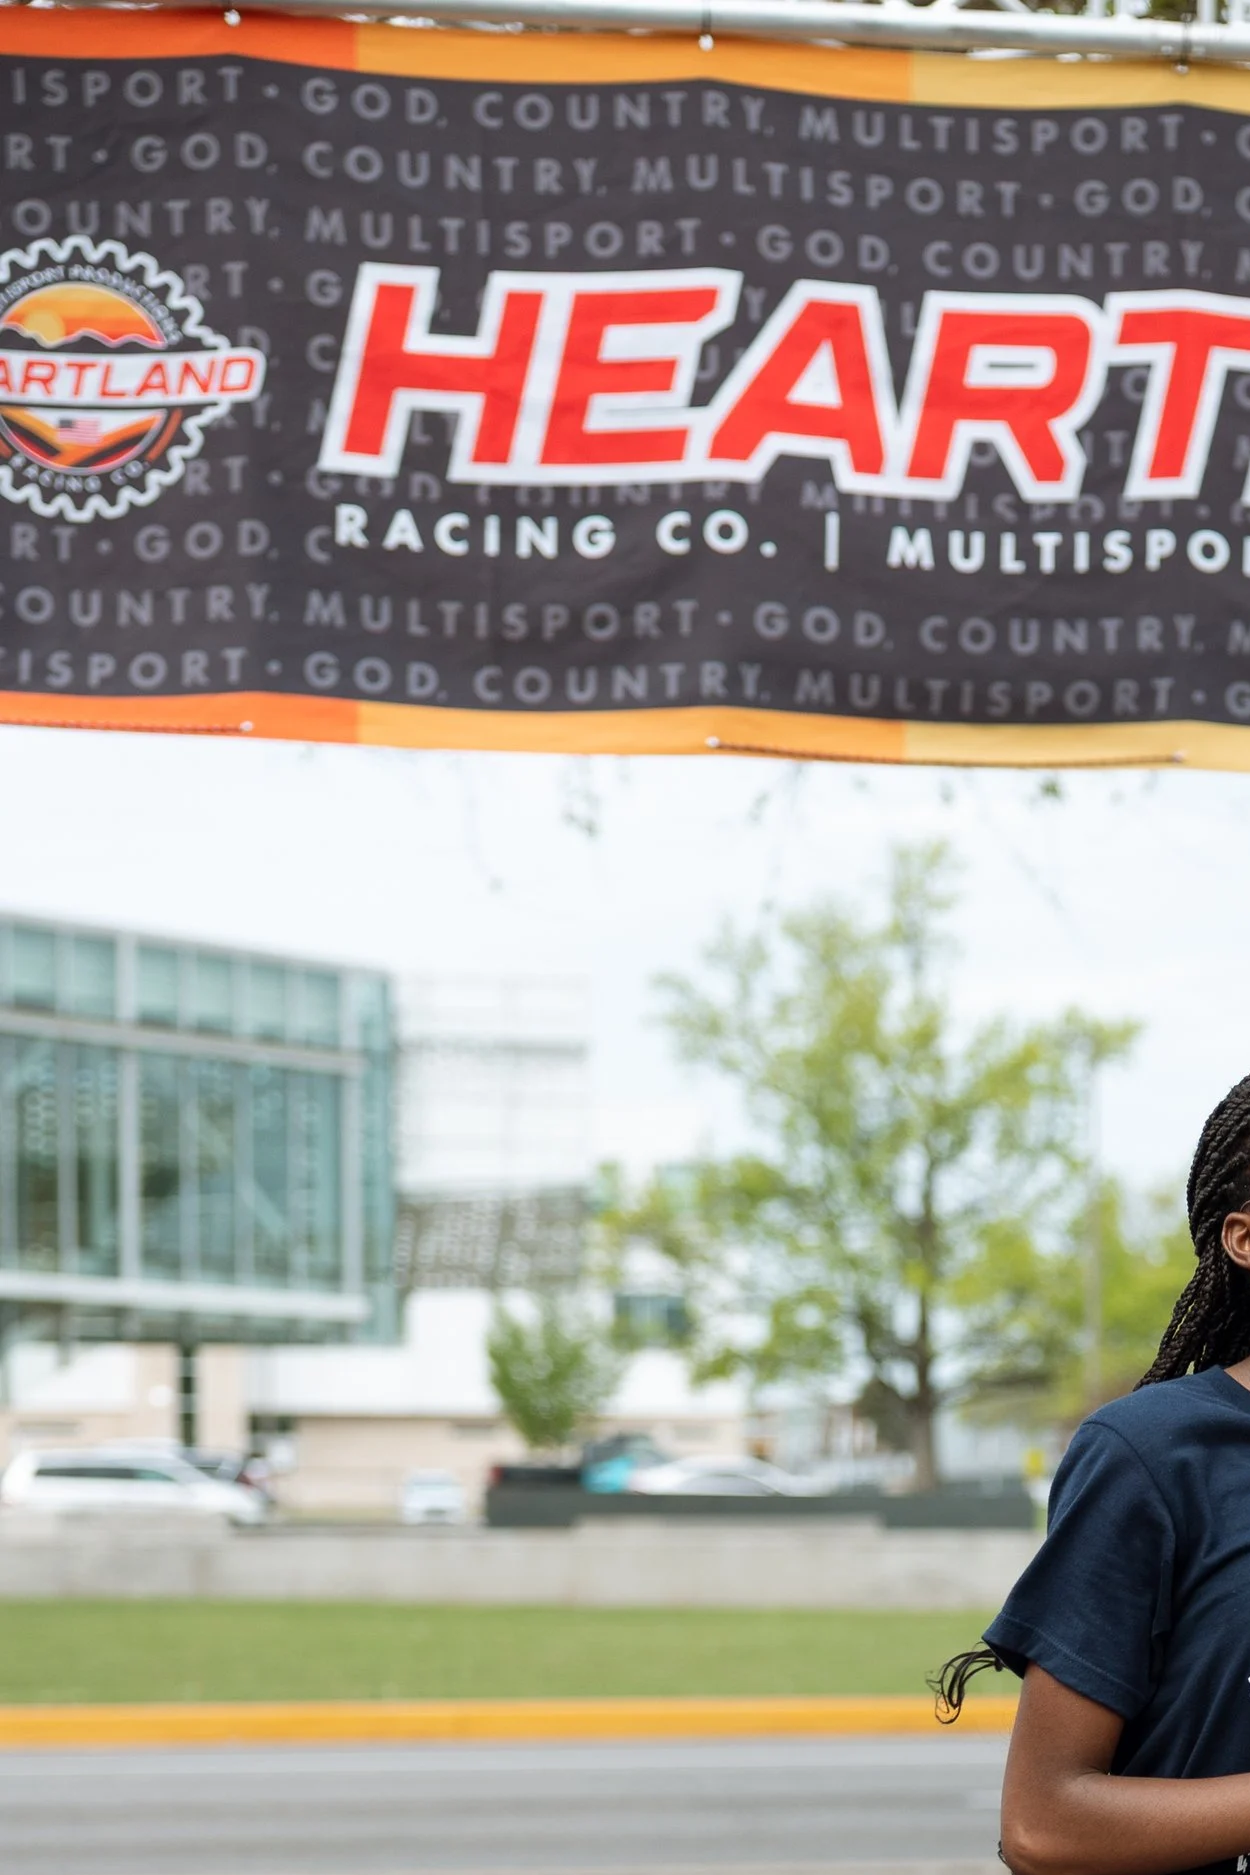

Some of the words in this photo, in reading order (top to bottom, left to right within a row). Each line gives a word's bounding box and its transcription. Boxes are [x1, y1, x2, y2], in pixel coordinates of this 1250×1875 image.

[798, 104, 1184, 156] MULTISPORT
[630, 153, 1022, 219] MULTISPORT
[304, 206, 702, 256] MULTISPORT
[335, 502, 617, 559] RACING
[656, 509, 778, 558] CO.
[0, 583, 280, 627] OUNTRY,
[304, 589, 699, 642] MULTISPORT
[795, 668, 1176, 718] MULTISPORT
